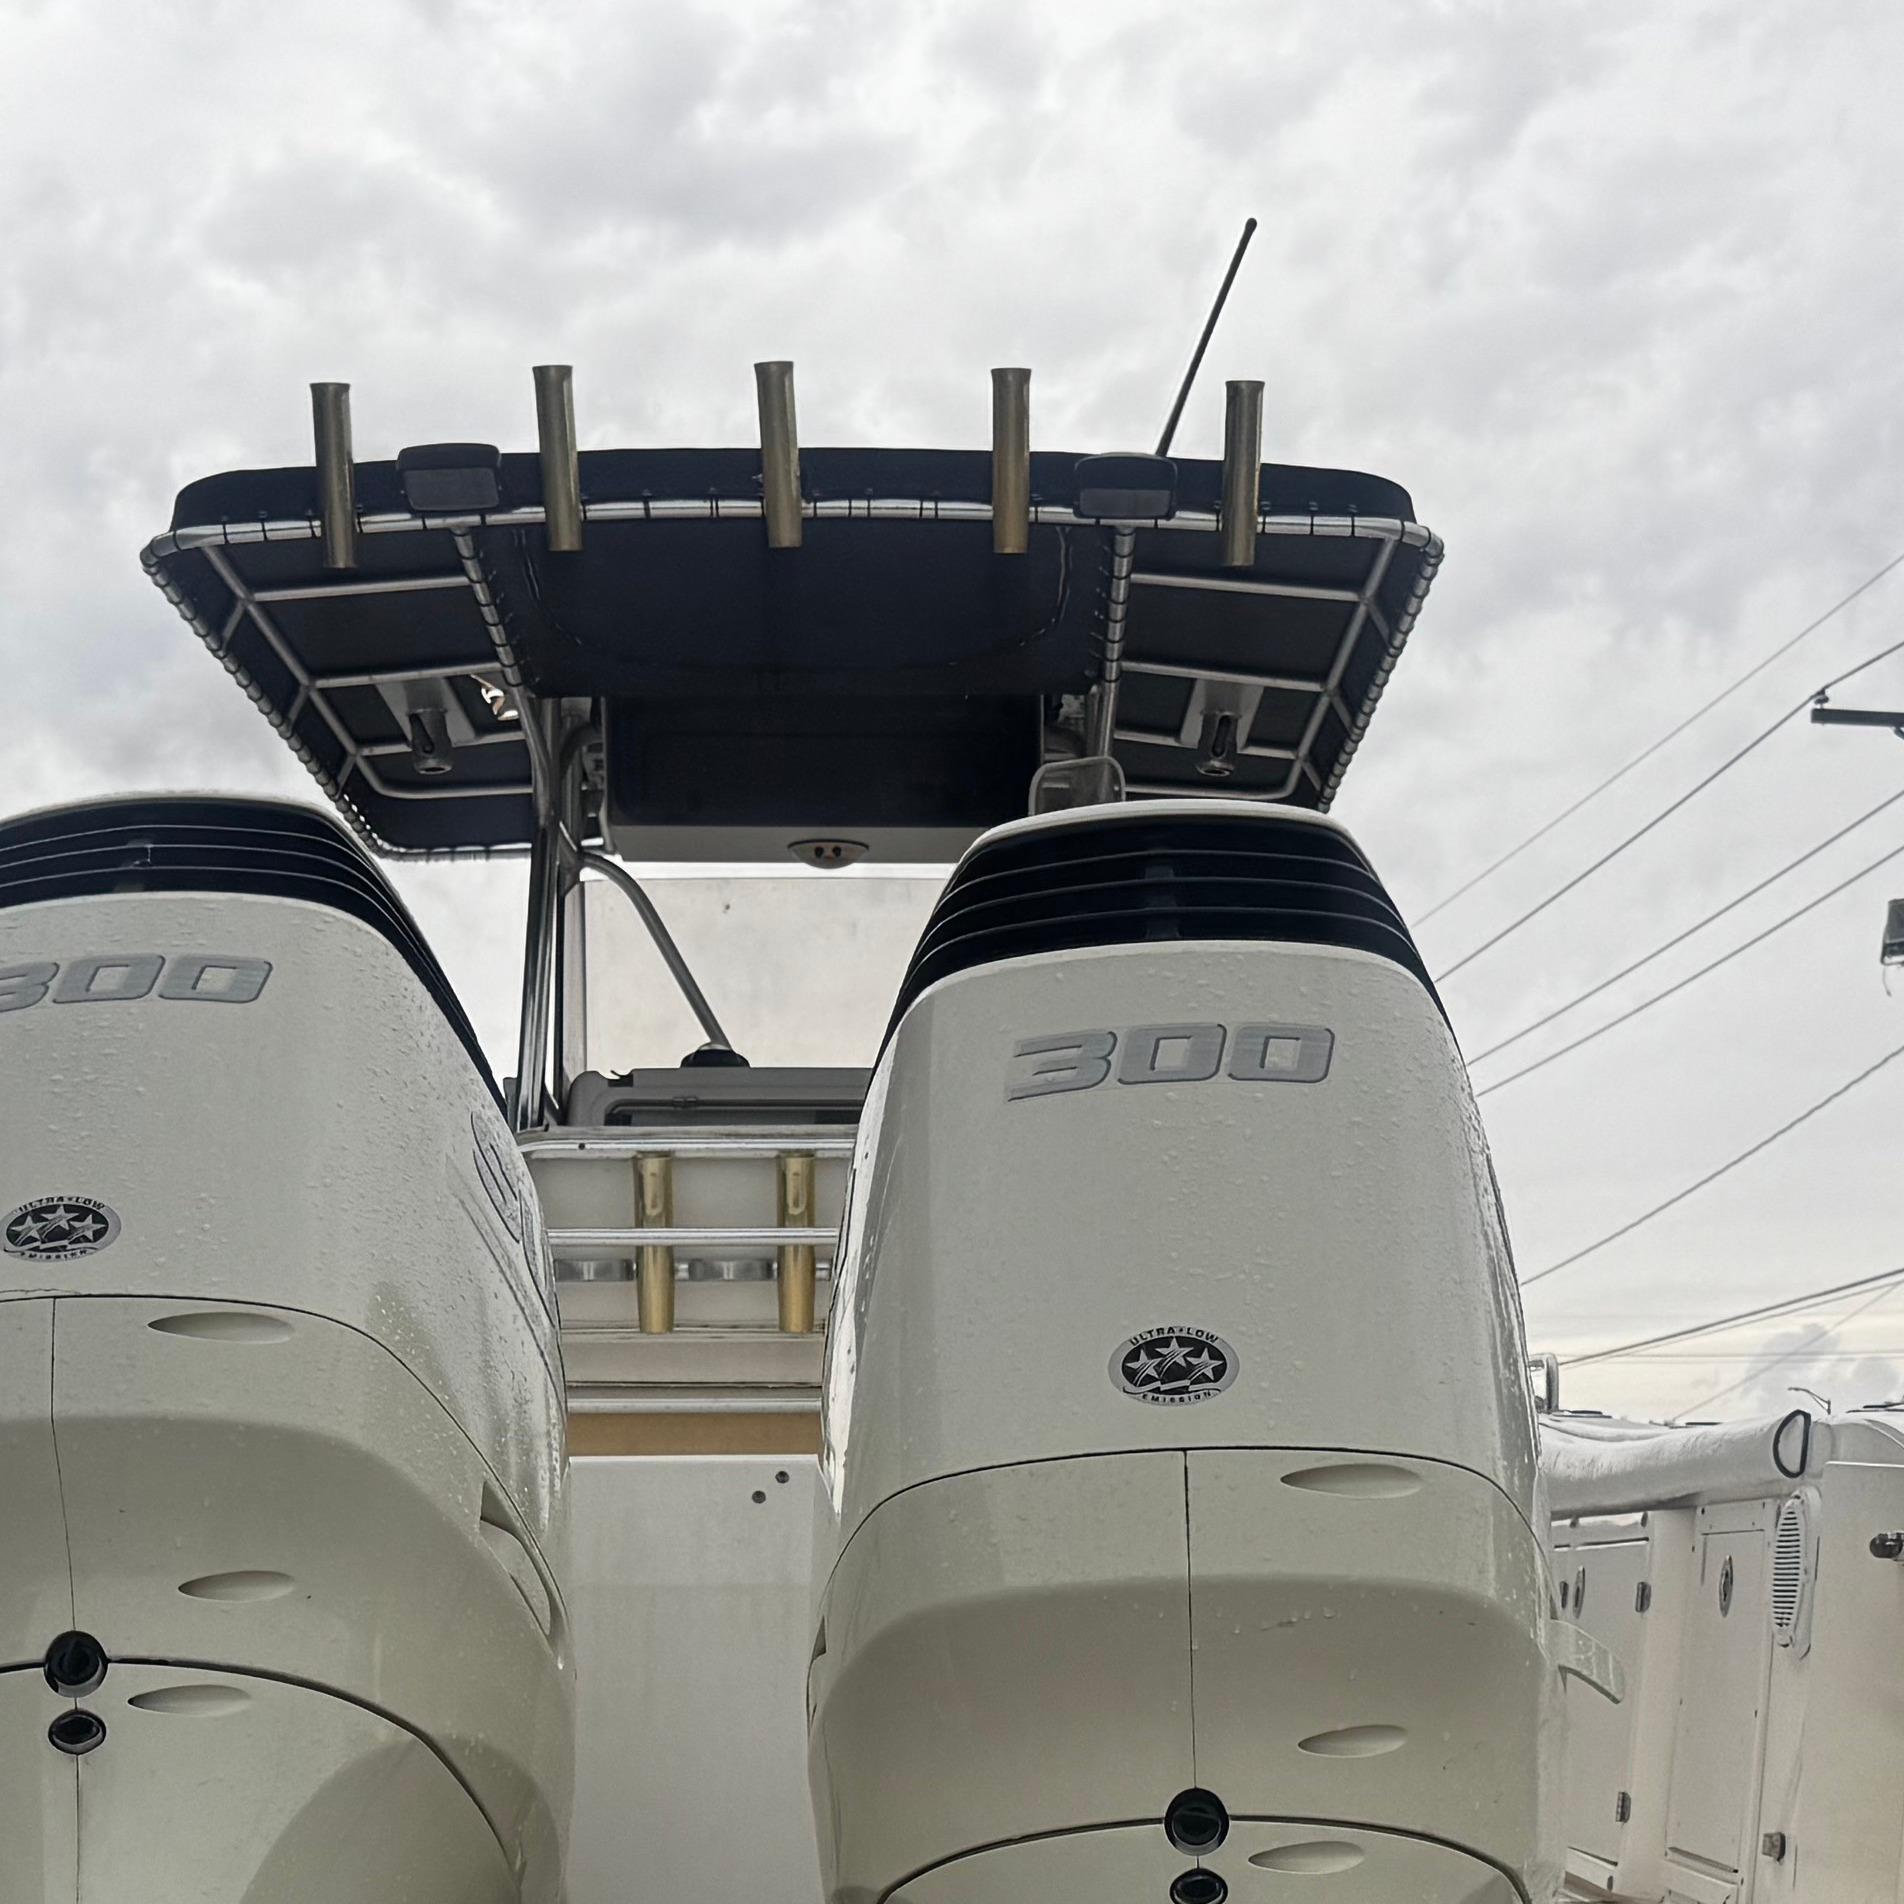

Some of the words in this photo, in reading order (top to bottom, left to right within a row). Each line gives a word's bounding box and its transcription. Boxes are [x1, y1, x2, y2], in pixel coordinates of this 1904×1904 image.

[1003, 1022, 1336, 1102] 300
[1128, 1326, 1176, 1346] ULTRA
[1186, 1326, 1219, 1344] LOW
[1142, 1391, 1212, 1404] EMISSION
